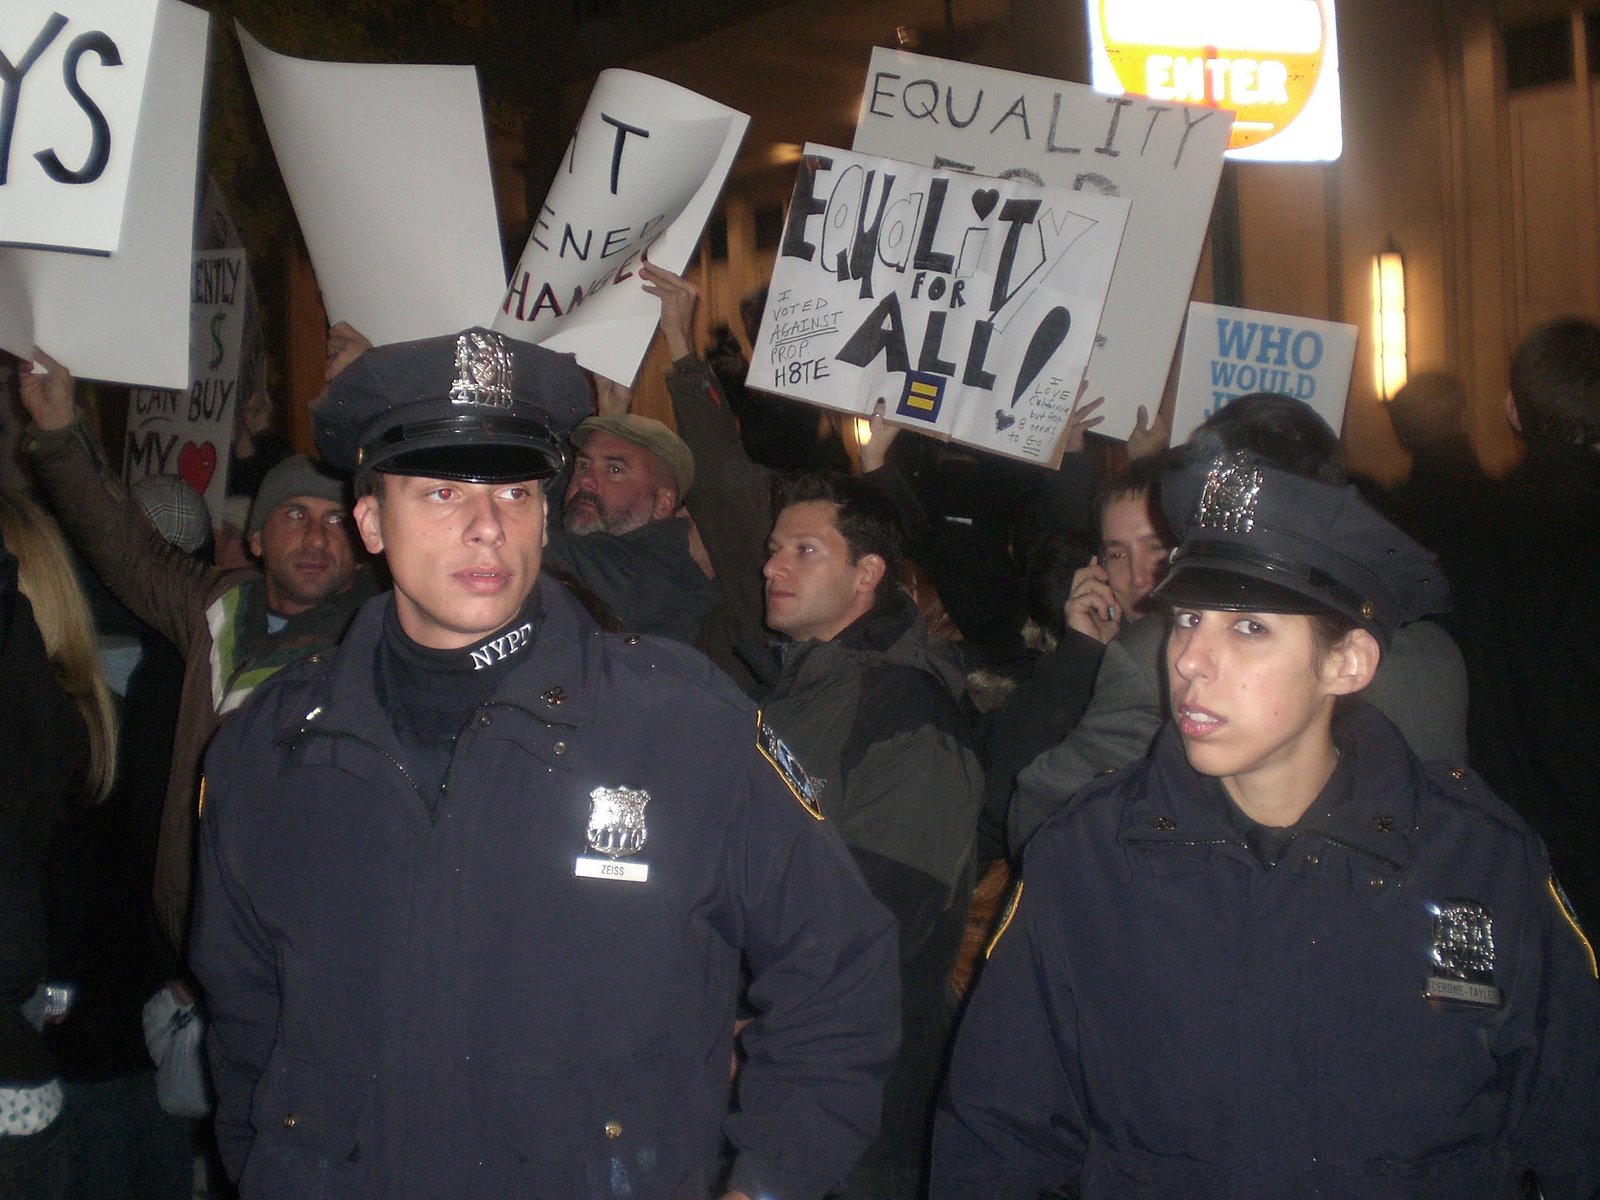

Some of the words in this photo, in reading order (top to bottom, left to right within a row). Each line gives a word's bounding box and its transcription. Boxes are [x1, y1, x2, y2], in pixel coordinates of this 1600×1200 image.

[1146, 55, 1288, 104] ENTER
[869, 71, 1214, 170] EQUALITY
[773, 297, 828, 322] VOTED
[778, 289, 793, 303] I
[911, 271, 967, 309] FOR
[769, 310, 844, 345] AGAINST
[1216, 317, 1325, 371] WHO
[775, 356, 830, 388] H8TE
[1211, 360, 1317, 401] WOULD
[187, 379, 236, 423] BUY
[1034, 383, 1072, 401] LOVE
[127, 429, 180, 484] MY
[469, 623, 532, 671] NYPD
[600, 864, 625, 877] ZEISS
